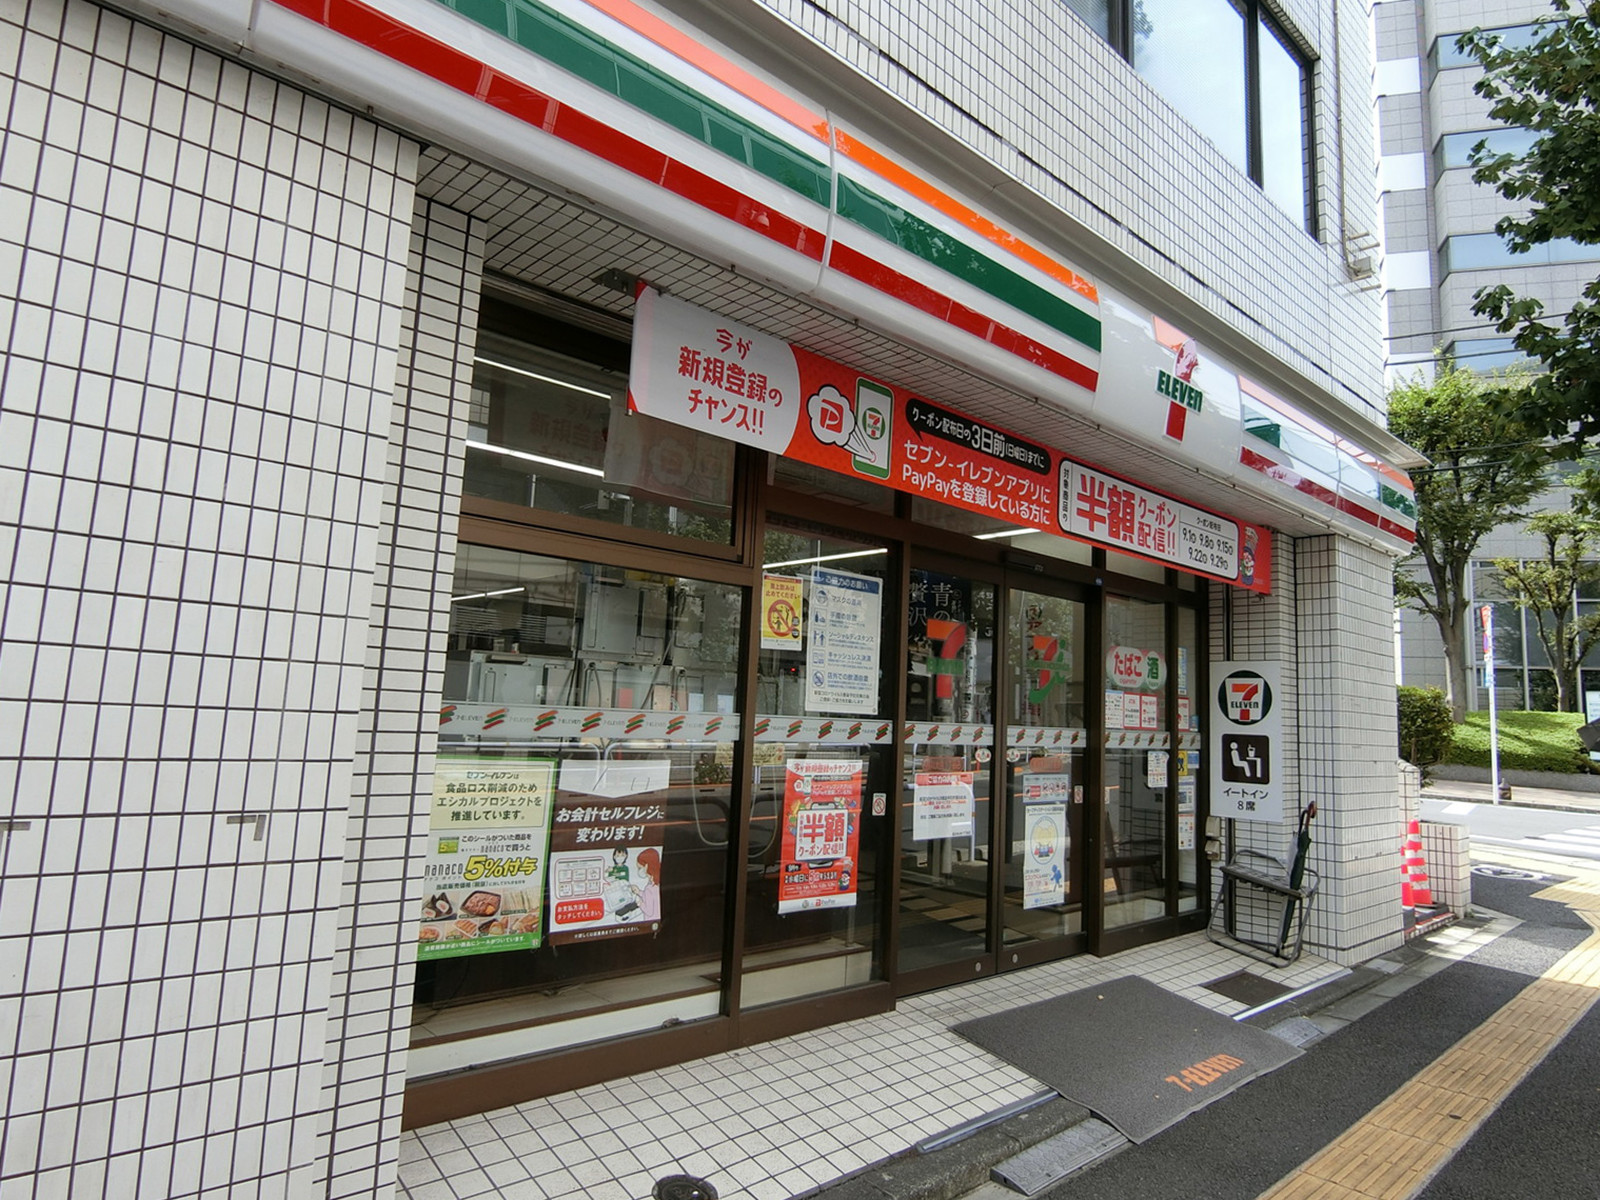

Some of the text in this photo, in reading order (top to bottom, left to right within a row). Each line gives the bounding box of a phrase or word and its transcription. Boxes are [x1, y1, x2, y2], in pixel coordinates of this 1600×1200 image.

[715, 328, 753, 360] 今が
[678, 346, 783, 408] 新規登録の
[688, 388, 765, 436] チャンス!!
[902, 464, 1050, 525] PayPayを登録している方に
[1076, 474, 1135, 545] 半額
[1138, 495, 1177, 529] クーポン
[1138, 521, 1176, 556] 配信!!
[1114, 652, 1142, 677] たばこ
[1147, 656, 1159, 680] 酒
[437, 796, 542, 807] エシカルプロジェクトを
[445, 783, 538, 794] 食品ロス削減のため
[1223, 787, 1269, 800] イートイン
[451, 810, 525, 821] 推進しています。
[556, 805, 665, 822] お会計セルフレジに
[461, 834, 532, 843] このシールがついた商品を
[575, 825, 645, 843] 変わります!
[803, 813, 845, 844] 半額
[424, 863, 464, 877] nanaco
[463, 854, 538, 881] 5%付与
